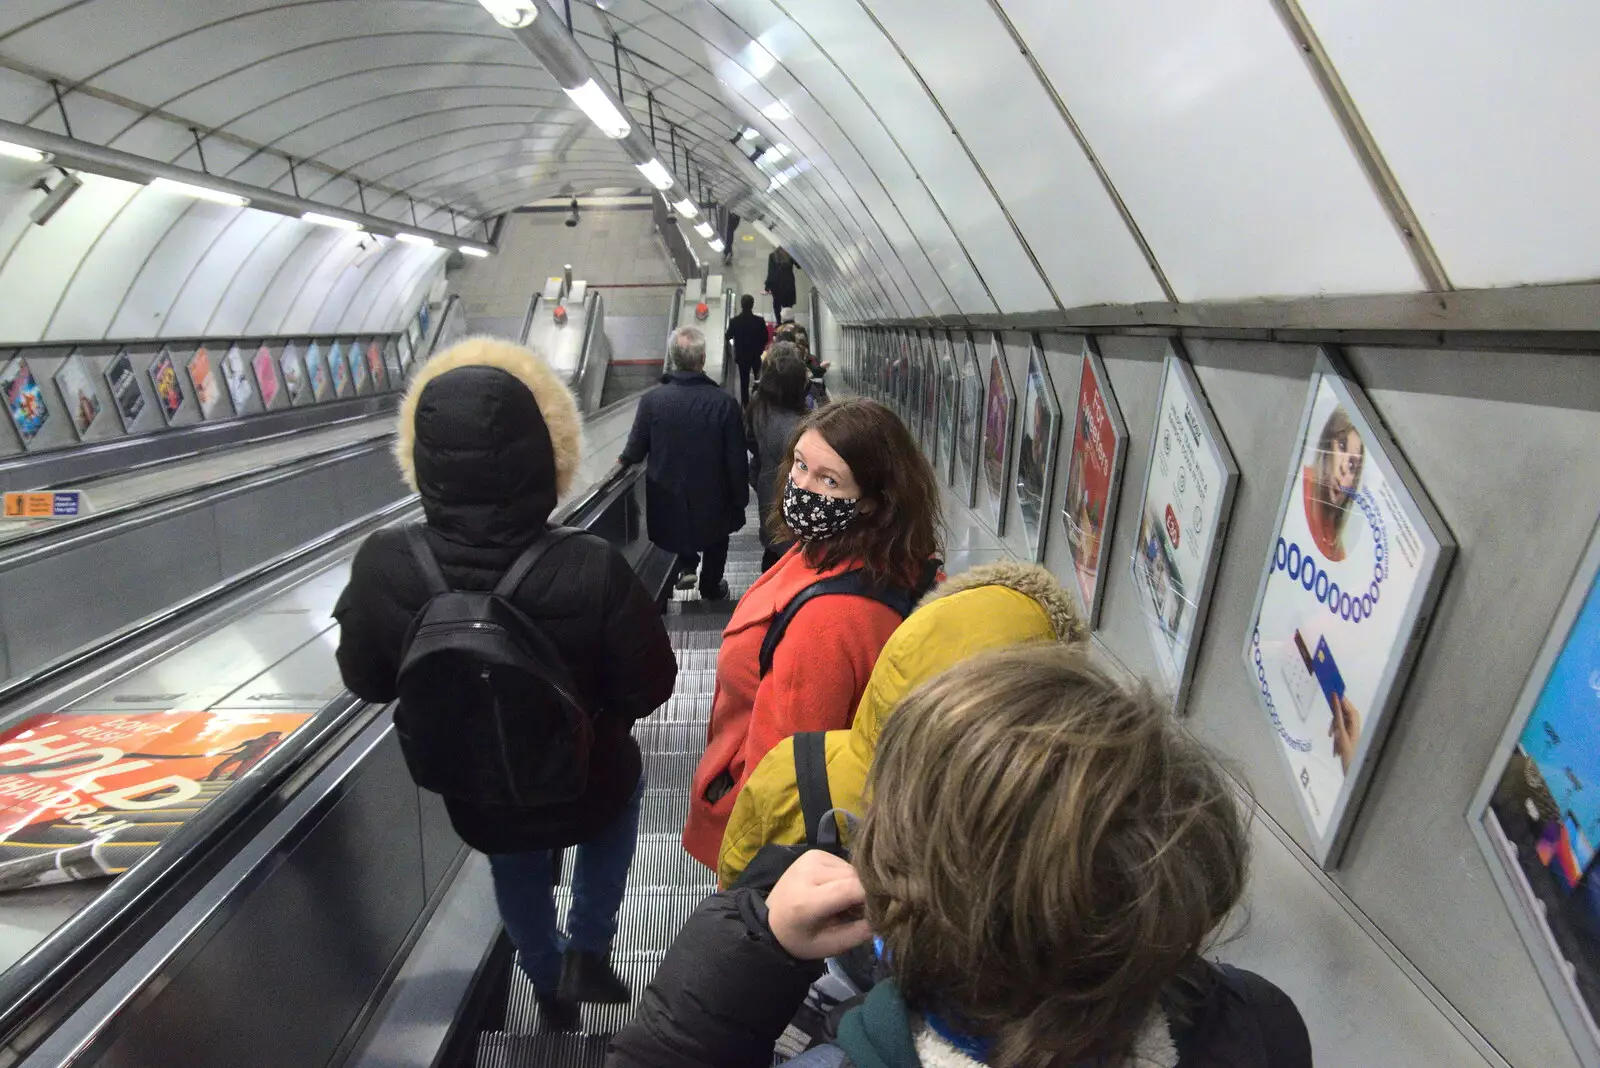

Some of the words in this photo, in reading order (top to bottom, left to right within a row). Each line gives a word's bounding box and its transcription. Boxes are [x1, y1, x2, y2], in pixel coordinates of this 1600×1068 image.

[1093, 389, 1104, 428] For
[70, 726, 132, 743] RUSH
[0, 734, 201, 810] HOLD
